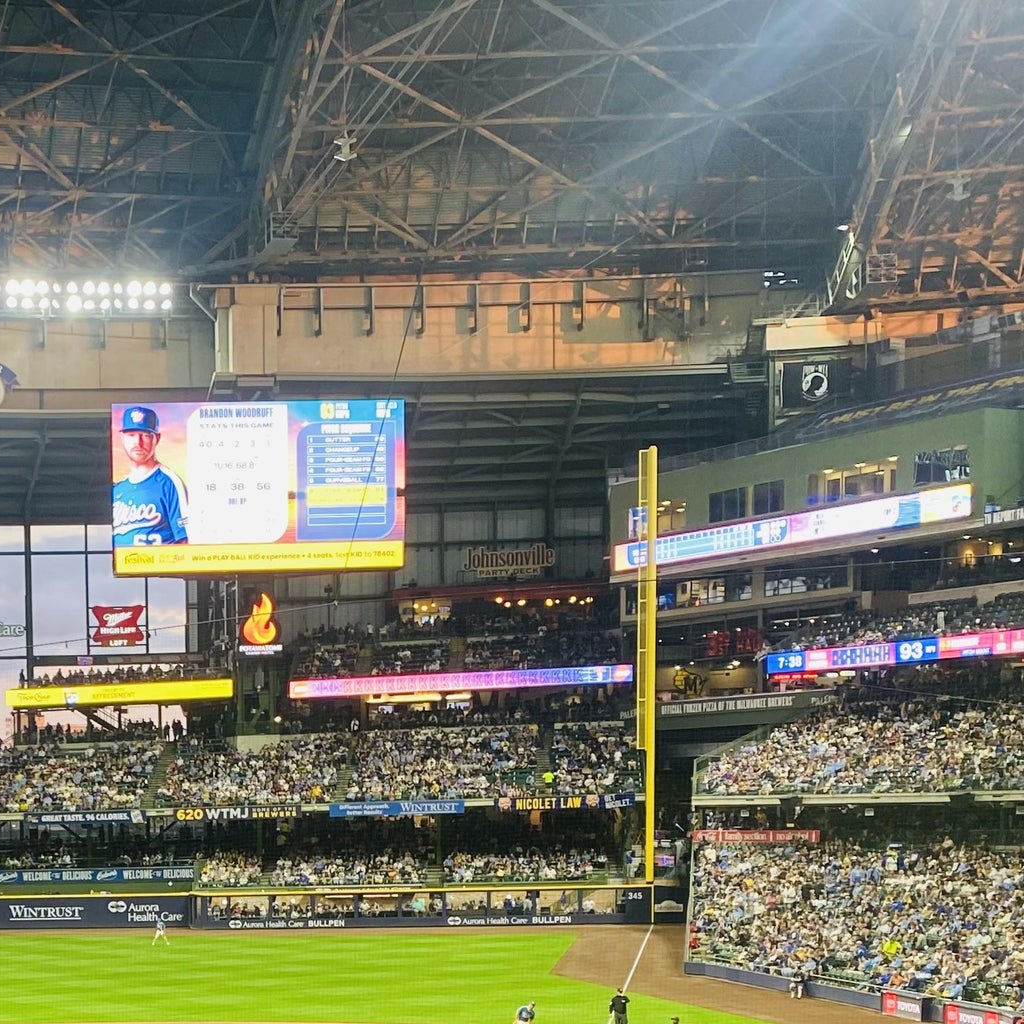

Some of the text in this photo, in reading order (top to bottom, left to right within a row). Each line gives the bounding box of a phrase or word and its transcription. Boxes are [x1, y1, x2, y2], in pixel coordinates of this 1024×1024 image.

[199, 407, 274, 419] BRANDON WOODRUFF
[464, 544, 555, 571] Johnsonville
[478, 567, 539, 577] PARTY DECK
[100, 627, 137, 635] HIGH LIFE
[109, 639, 128, 647] LOFT
[899, 642, 924, 659] 93
[702, 702, 717, 713] PIZZA
[400, 802, 459, 812] WINTRUST
[515, 796, 582, 810] NICOLET LAW
[41, 814, 63, 823] GREAT
[63, 813, 85, 822] TASTE.
[95, 812, 130, 821] CALORIES.
[176, 807, 249, 821] 620 WTMJ
[22, 872, 52, 882] WELCOME
[62, 870, 93, 881] DELICIOUS
[123, 868, 194, 880] WELCOME DELICIOUS
[628, 891, 643, 900] 345
[9, 905, 84, 918] WINTRUST
[128, 902, 160, 913] Aurora
[128, 911, 184, 922] Health Care
[462, 916, 572, 926] Aurora Health Care BULLPEN
[242, 919, 345, 929] Aurora Health Care BULLPEN
[897, 1000, 921, 1014] TOYOTA
